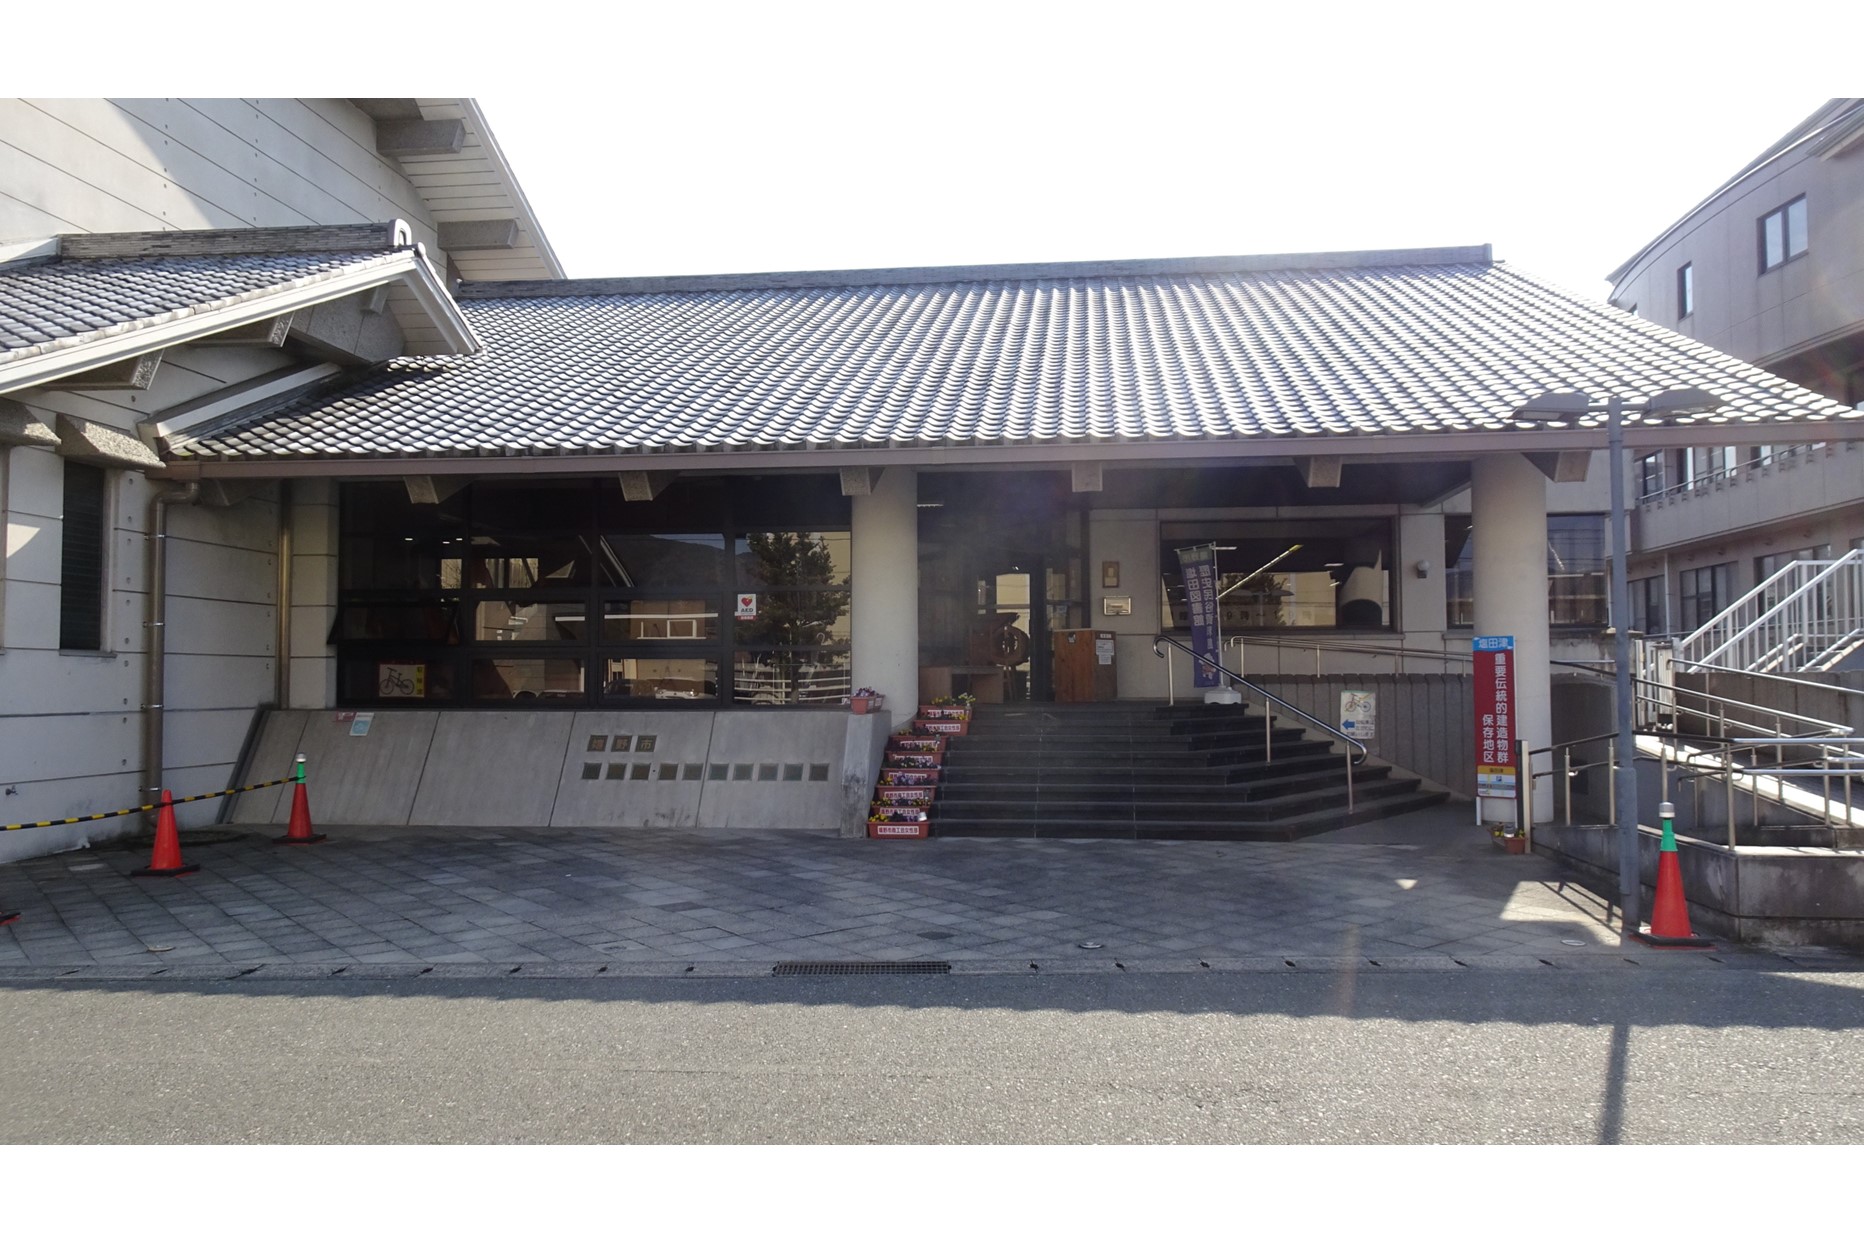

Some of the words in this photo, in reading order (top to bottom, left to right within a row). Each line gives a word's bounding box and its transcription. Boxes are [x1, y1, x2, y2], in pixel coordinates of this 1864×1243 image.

[1479, 638, 1508, 649] 塩田津
[1495, 653, 1508, 764] 重要伝統的建造物群
[592, 738, 653, 750] 嬉野市
[1482, 714, 1495, 763] 保存地区
